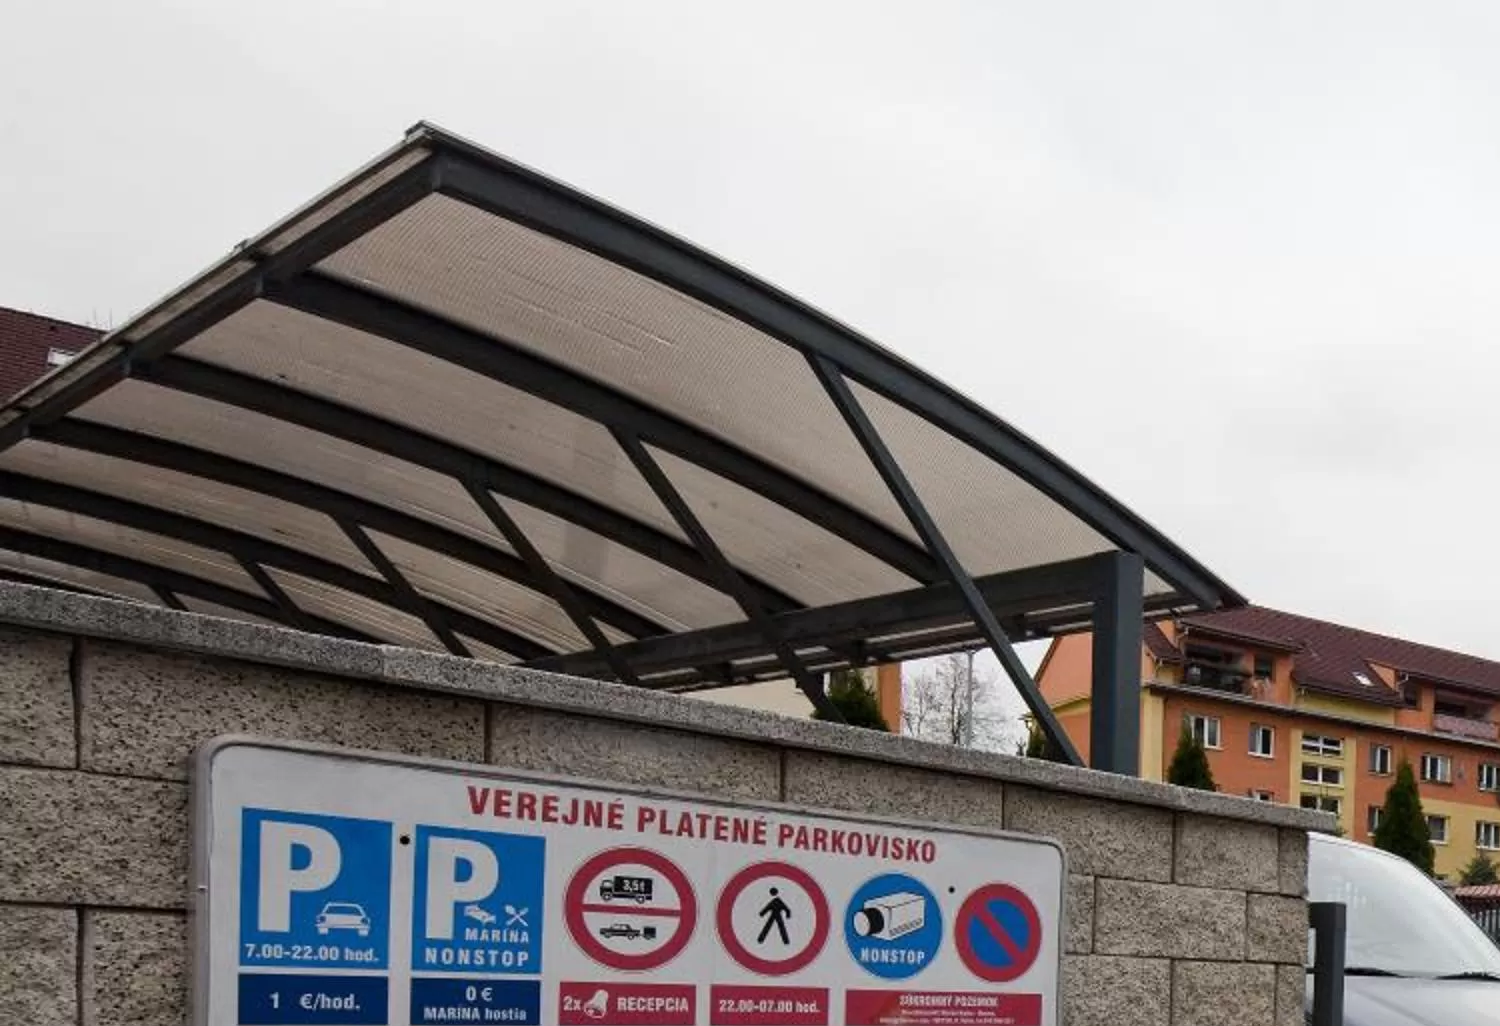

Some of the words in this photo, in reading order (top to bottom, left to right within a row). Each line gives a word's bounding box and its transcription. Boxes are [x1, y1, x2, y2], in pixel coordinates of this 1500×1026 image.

[467, 786, 625, 830] VEREJNÉ
[637, 807, 767, 846] PLATENÉ
[778, 823, 937, 864] PARKOVISKO
[257, 820, 342, 933] P
[425, 836, 499, 940] P
[245, 943, 340, 962] 7.00-22.00
[344, 947, 379, 963] hod.
[424, 948, 530, 967] NONSTOP
[860, 948, 926, 966] NONSTOP
[270, 993, 280, 1010] 1
[465, 986, 477, 1001] 0
[480, 987, 492, 1001] €
[563, 996, 581, 1011] 2x
[617, 996, 689, 1013] RECEPCIA
[719, 998, 794, 1014] 22.00-07.00
[796, 1000, 820, 1014] hod.
[484, 1007, 527, 1022] hostia
